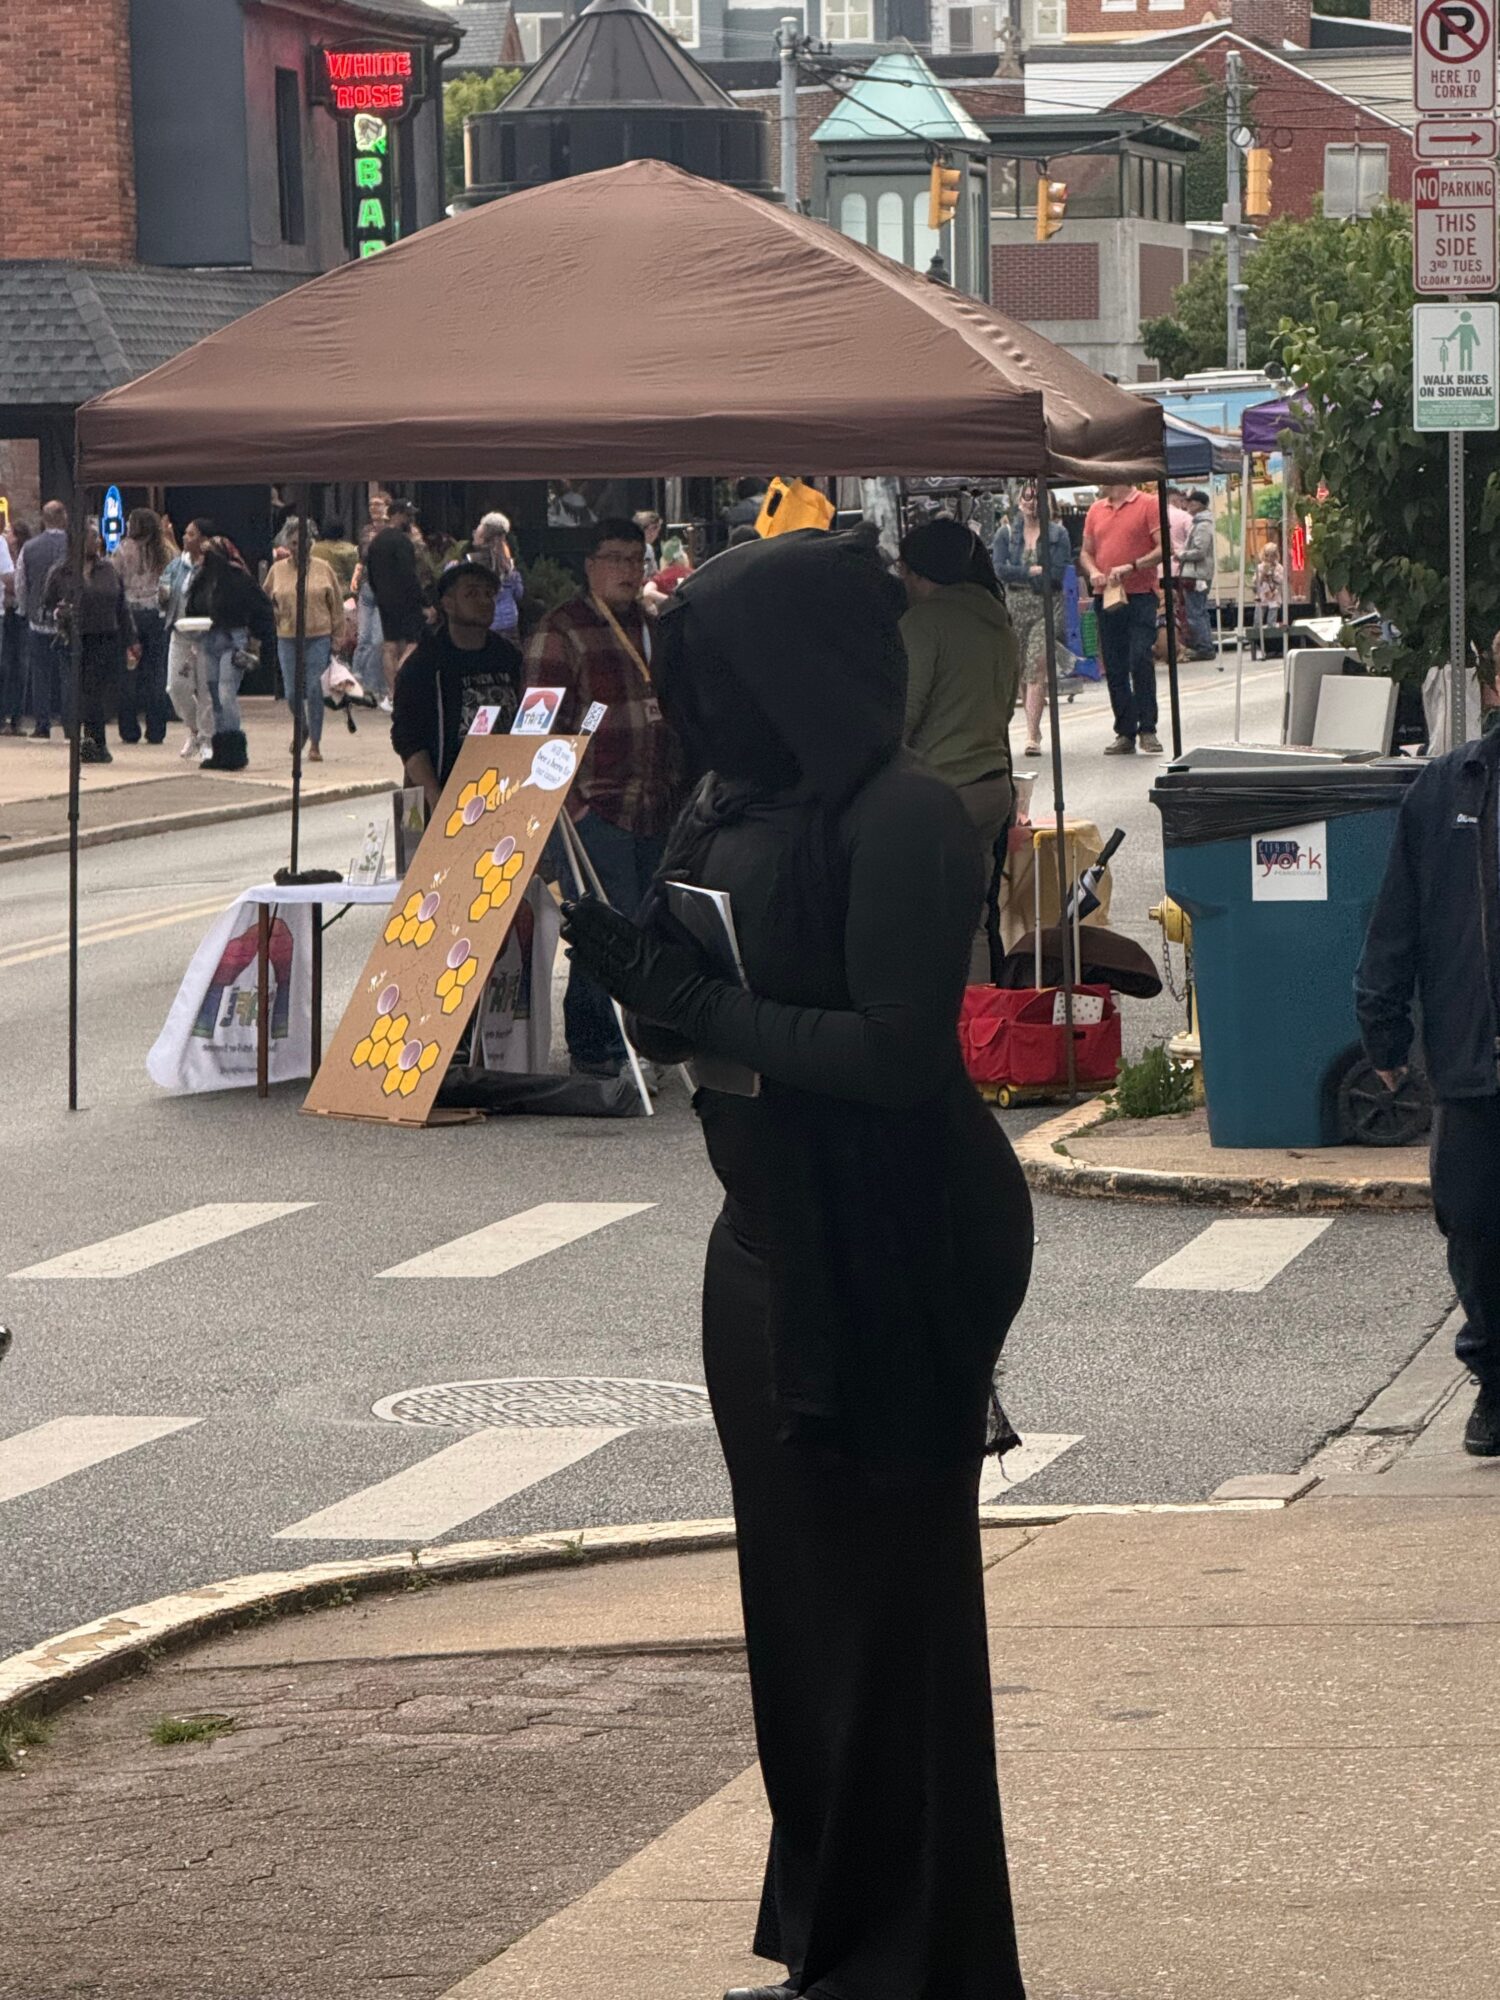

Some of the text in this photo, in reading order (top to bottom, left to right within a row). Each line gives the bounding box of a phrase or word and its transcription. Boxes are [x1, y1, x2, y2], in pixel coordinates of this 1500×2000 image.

[324, 50, 412, 79] WHITE
[1431, 70, 1481, 84] HERE TO
[331, 84, 403, 109] ROSE
[1435, 84, 1477, 98] CORNER
[1417, 177, 1491, 201] NO PARKING
[1435, 213, 1476, 233] THIS
[1435, 237, 1477, 257] SIDE
[1453, 259, 1482, 273] TUES
[1423, 374, 1489, 386] WALK BIKES
[1420, 386, 1493, 398] ON SIDEWALK
[1259, 846, 1323, 878] york
